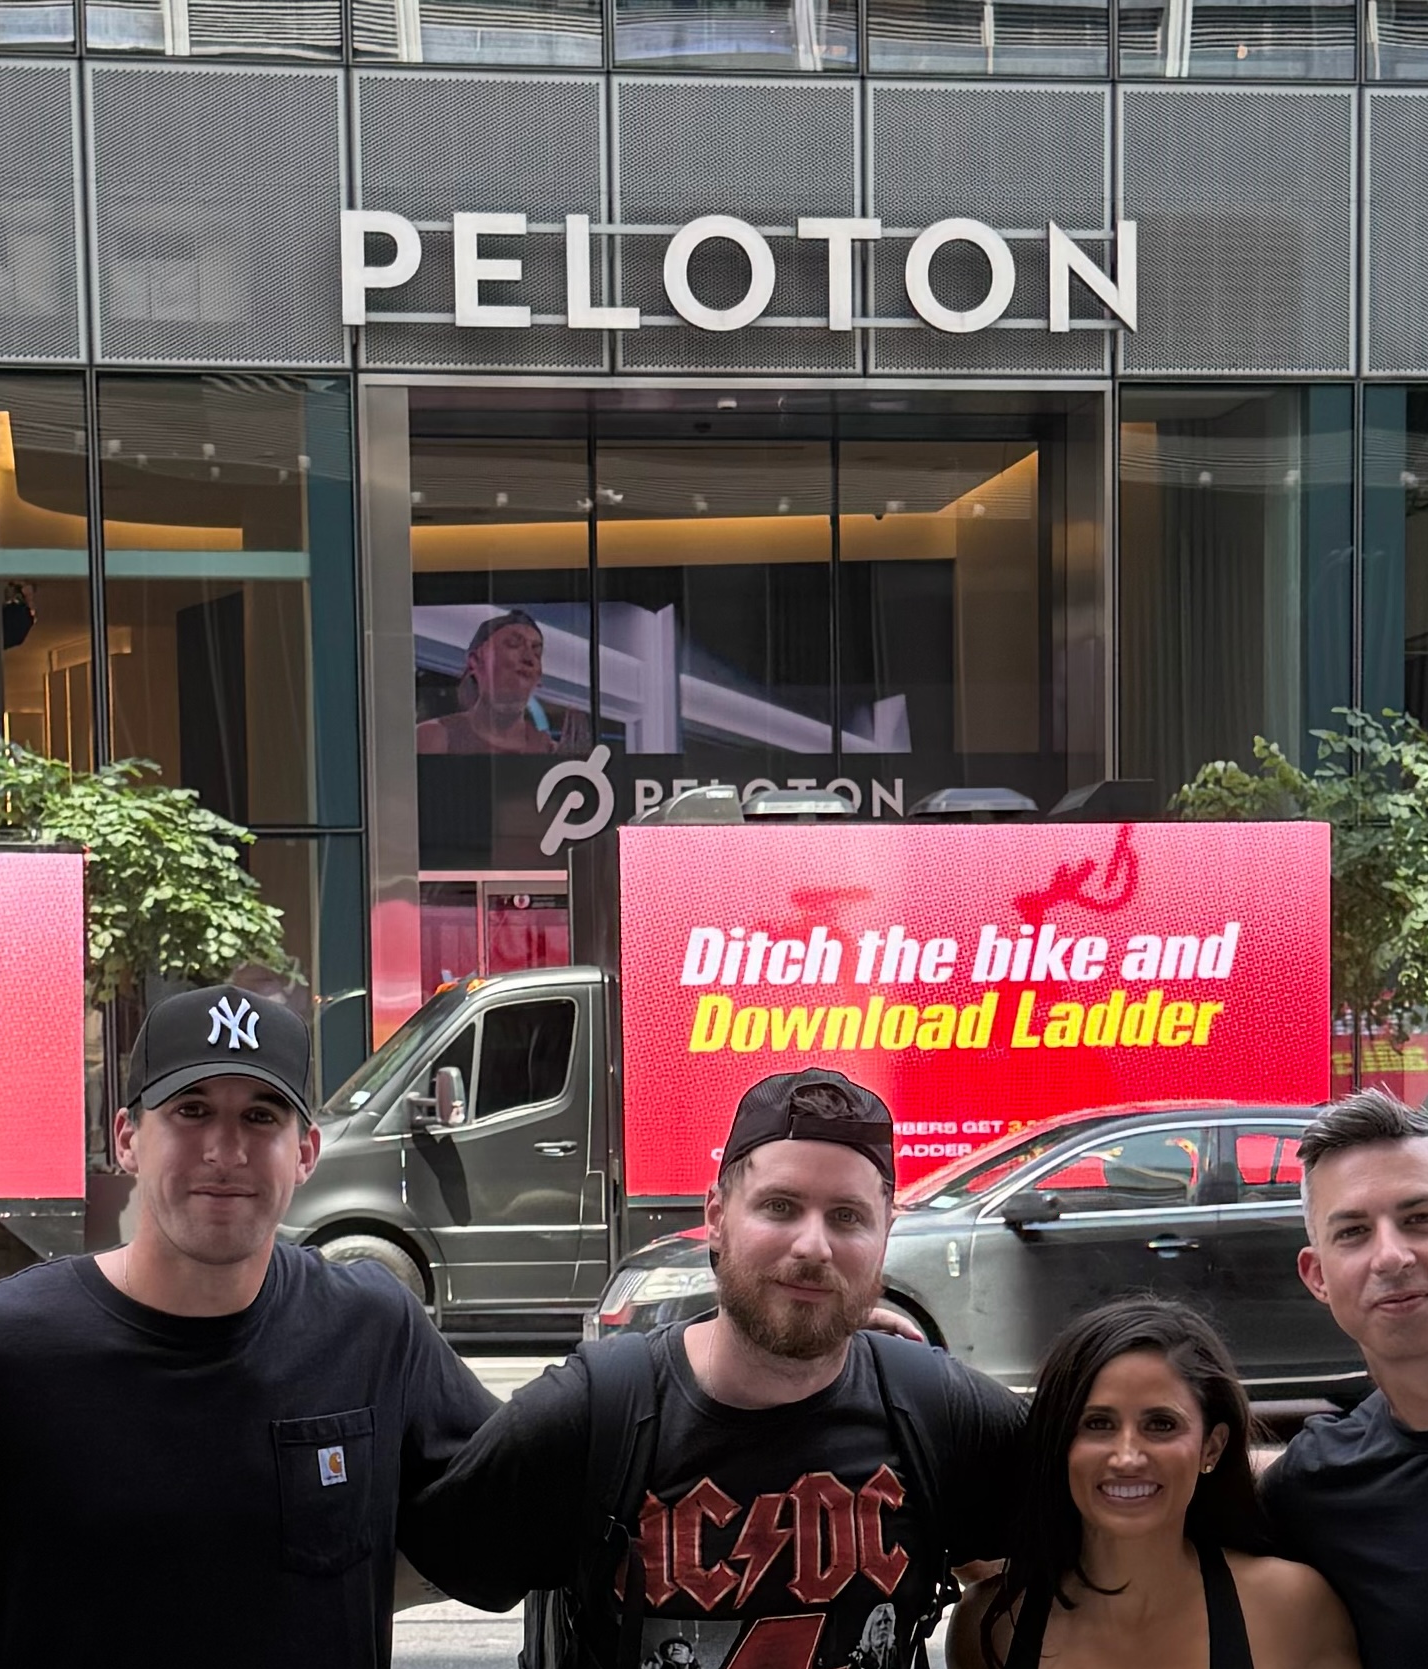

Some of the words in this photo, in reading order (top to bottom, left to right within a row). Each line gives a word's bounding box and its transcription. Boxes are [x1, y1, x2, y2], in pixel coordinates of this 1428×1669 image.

[340, 209, 1138, 334] PELOTON
[680, 926, 843, 986] Ditch
[854, 925, 958, 984] the
[972, 923, 1109, 983] bike
[1121, 921, 1241, 981] and
[688, 994, 999, 1052] Download
[1011, 989, 1223, 1049] Ladder
[893, 1121, 957, 1135] BERS
[962, 1120, 1004, 1134] GET
[899, 1143, 972, 1157] ADDER
[614, 1463, 909, 1611] AC/DC
